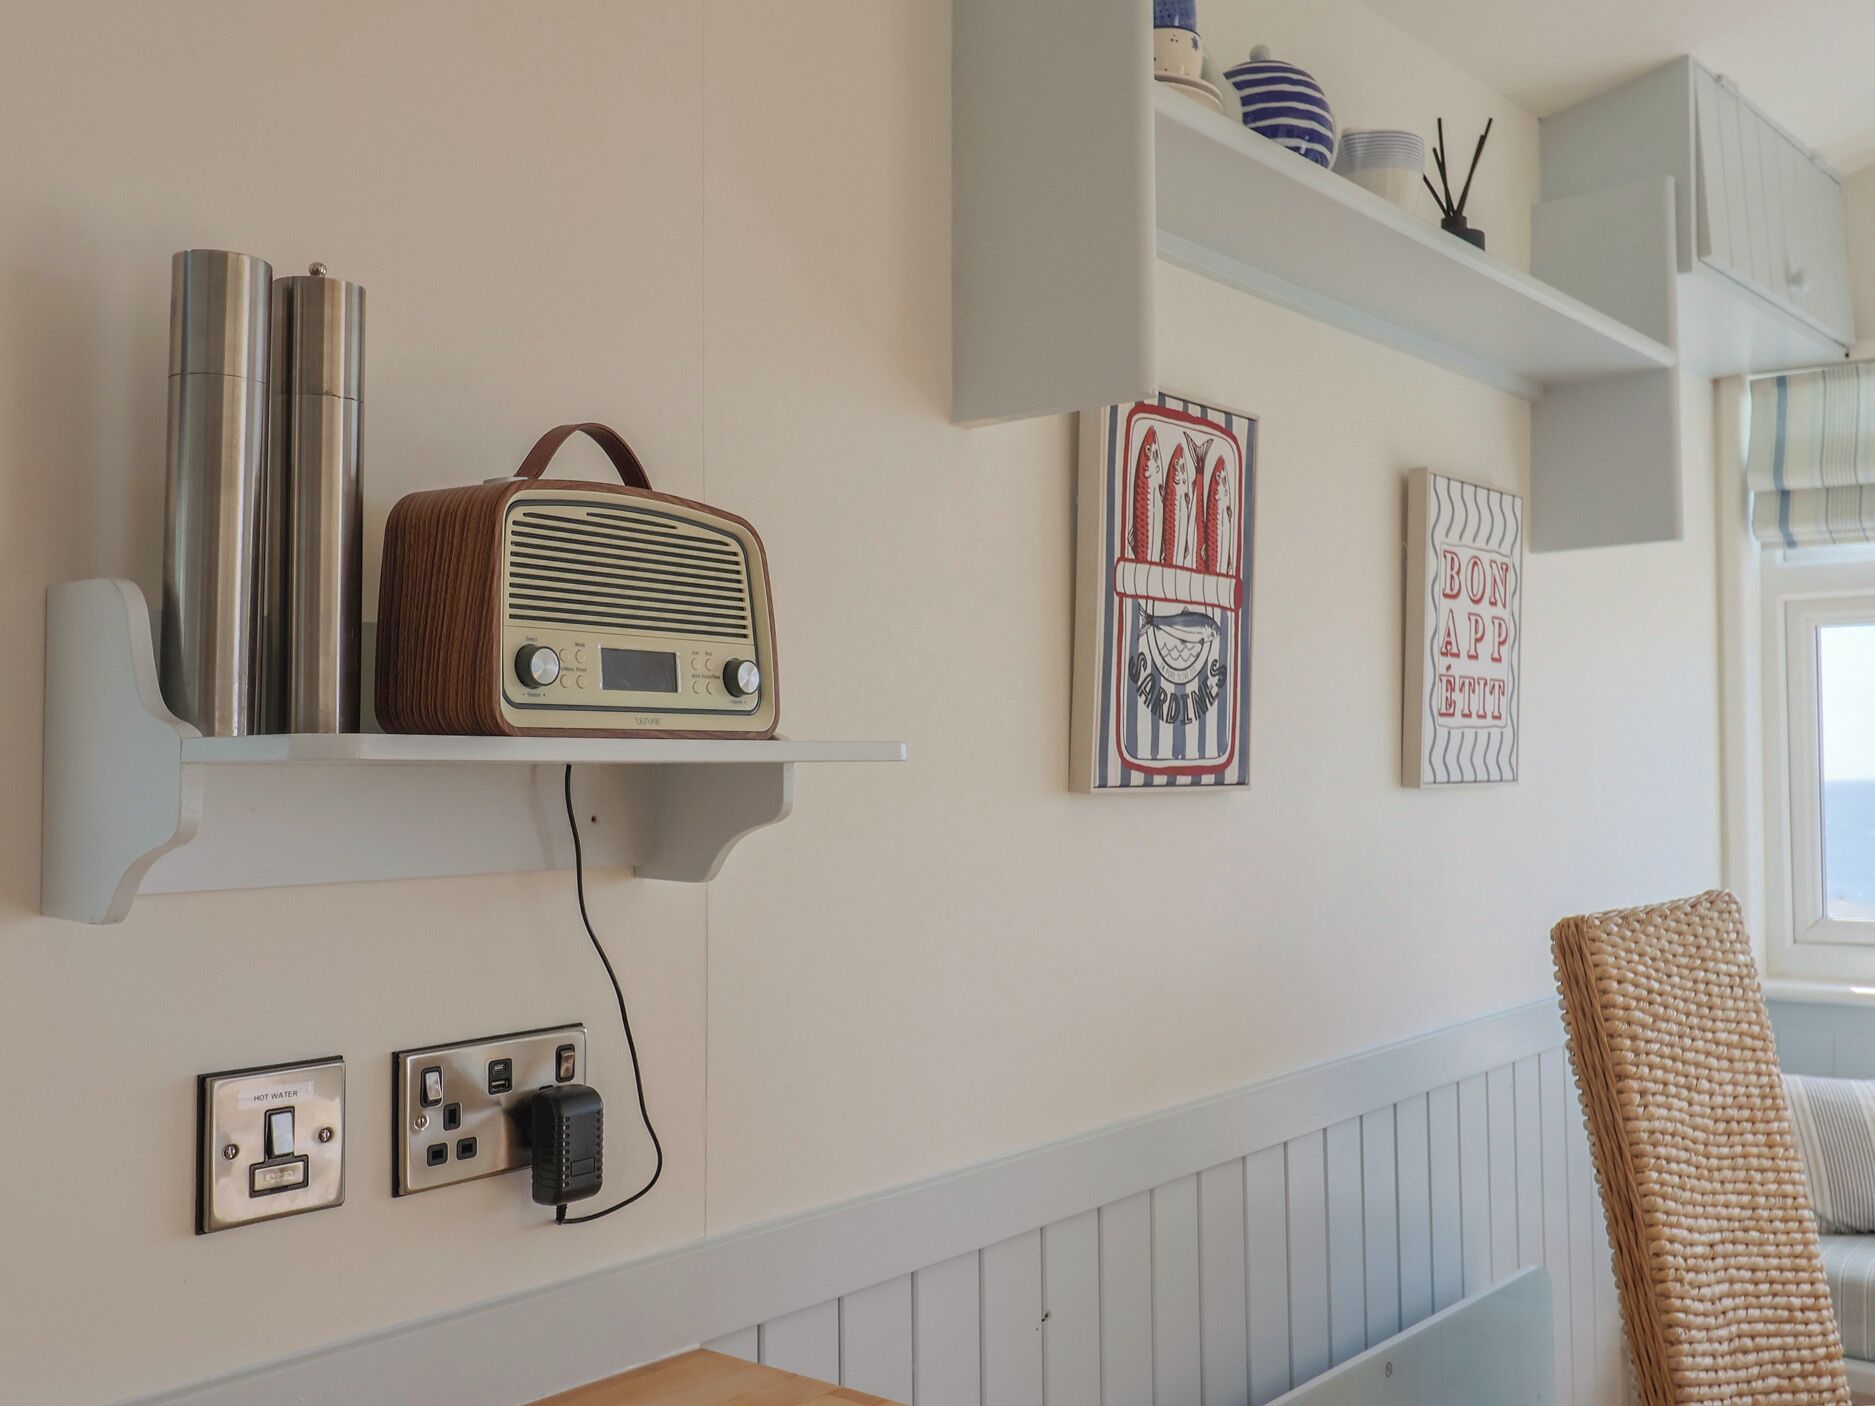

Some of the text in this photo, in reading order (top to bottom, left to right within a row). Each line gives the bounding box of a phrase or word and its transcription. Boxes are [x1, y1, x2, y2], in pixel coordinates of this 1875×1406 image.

[1442, 550, 1509, 609] BON
[1440, 608, 1508, 663] APP
[1128, 652, 1227, 726] SARDINES
[1438, 664, 1505, 720] ÉTIT
[253, 1090, 298, 1102] HOT WATER
